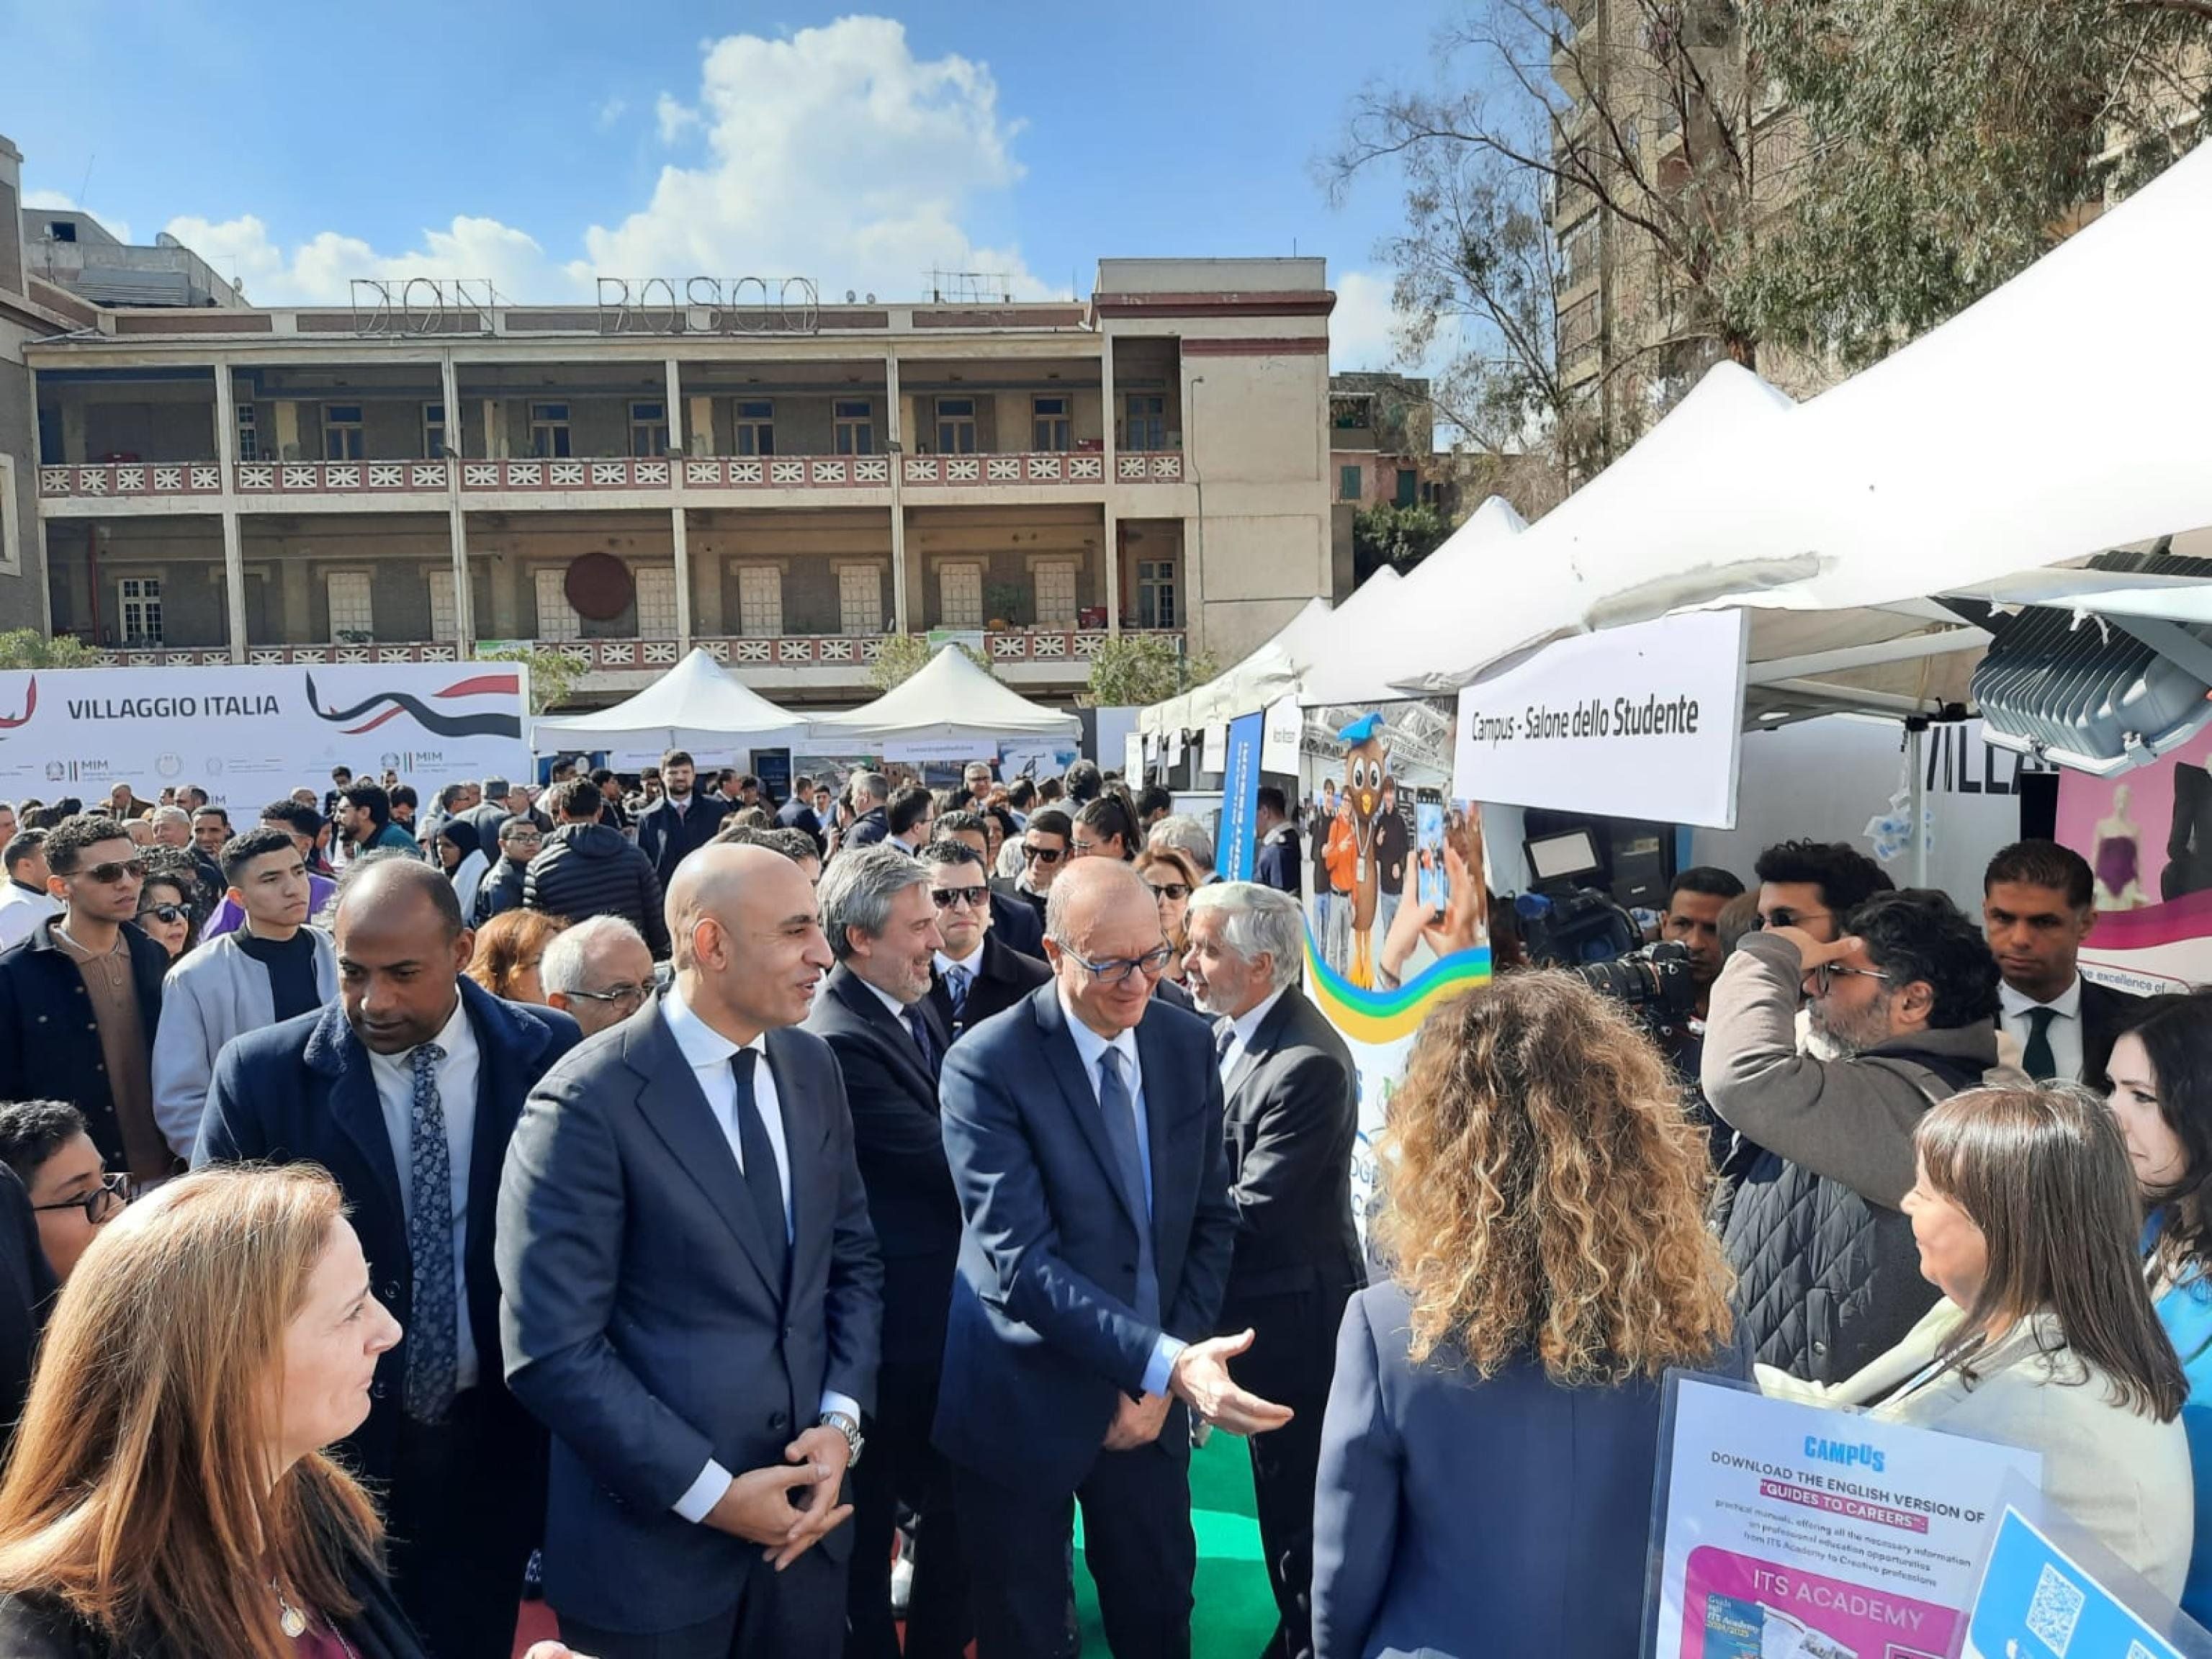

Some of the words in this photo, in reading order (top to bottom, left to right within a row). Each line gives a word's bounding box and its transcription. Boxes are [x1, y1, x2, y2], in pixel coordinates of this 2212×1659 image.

[351, 278, 495, 336] DON
[598, 276, 818, 333] BOSCO
[68, 697, 196, 719] VILLAGGIO
[204, 695, 279, 716] ITALIA
[1473, 711, 1514, 750] Campus
[1525, 704, 1568, 739] Salone
[1573, 698, 1609, 738] dello
[1613, 692, 1699, 737] Studente
[81, 760, 109, 770] MIM
[415, 752, 443, 762] MIM
[2097, 972, 2152, 991] excellence
[2154, 981, 2166, 995] of
[1711, 1451, 1793, 1480] DOWNLOAD
[1797, 1471, 1823, 1488] THE
[1827, 1478, 1890, 1503] ENGLISH
[1894, 1493, 1961, 1519] VERSION
[1964, 1509, 1986, 1524] OF
[1822, 1496, 1843, 1511] TO
[1743, 1531, 1764, 1545] from
[1766, 1537, 1781, 1548] ITS
[1784, 1541, 1825, 1560] Academy
[1827, 1552, 1838, 1562] to
[1840, 1555, 1879, 1573] Creative
[1881, 1568, 1937, 1586] professions
[1762, 1524, 1817, 1543] professional
[1820, 1538, 1863, 1556] education
[1867, 1550, 1930, 1571] opportunities
[1796, 1519, 1831, 1536] offering
[1834, 1527, 1845, 1537] all
[1847, 1529, 1861, 1542] the
[1865, 1536, 1910, 1555] necessary
[1915, 1548, 1971, 1567] information
[1753, 1569, 1790, 1596] ITS
[1795, 1583, 1925, 1631] ACADEMY
